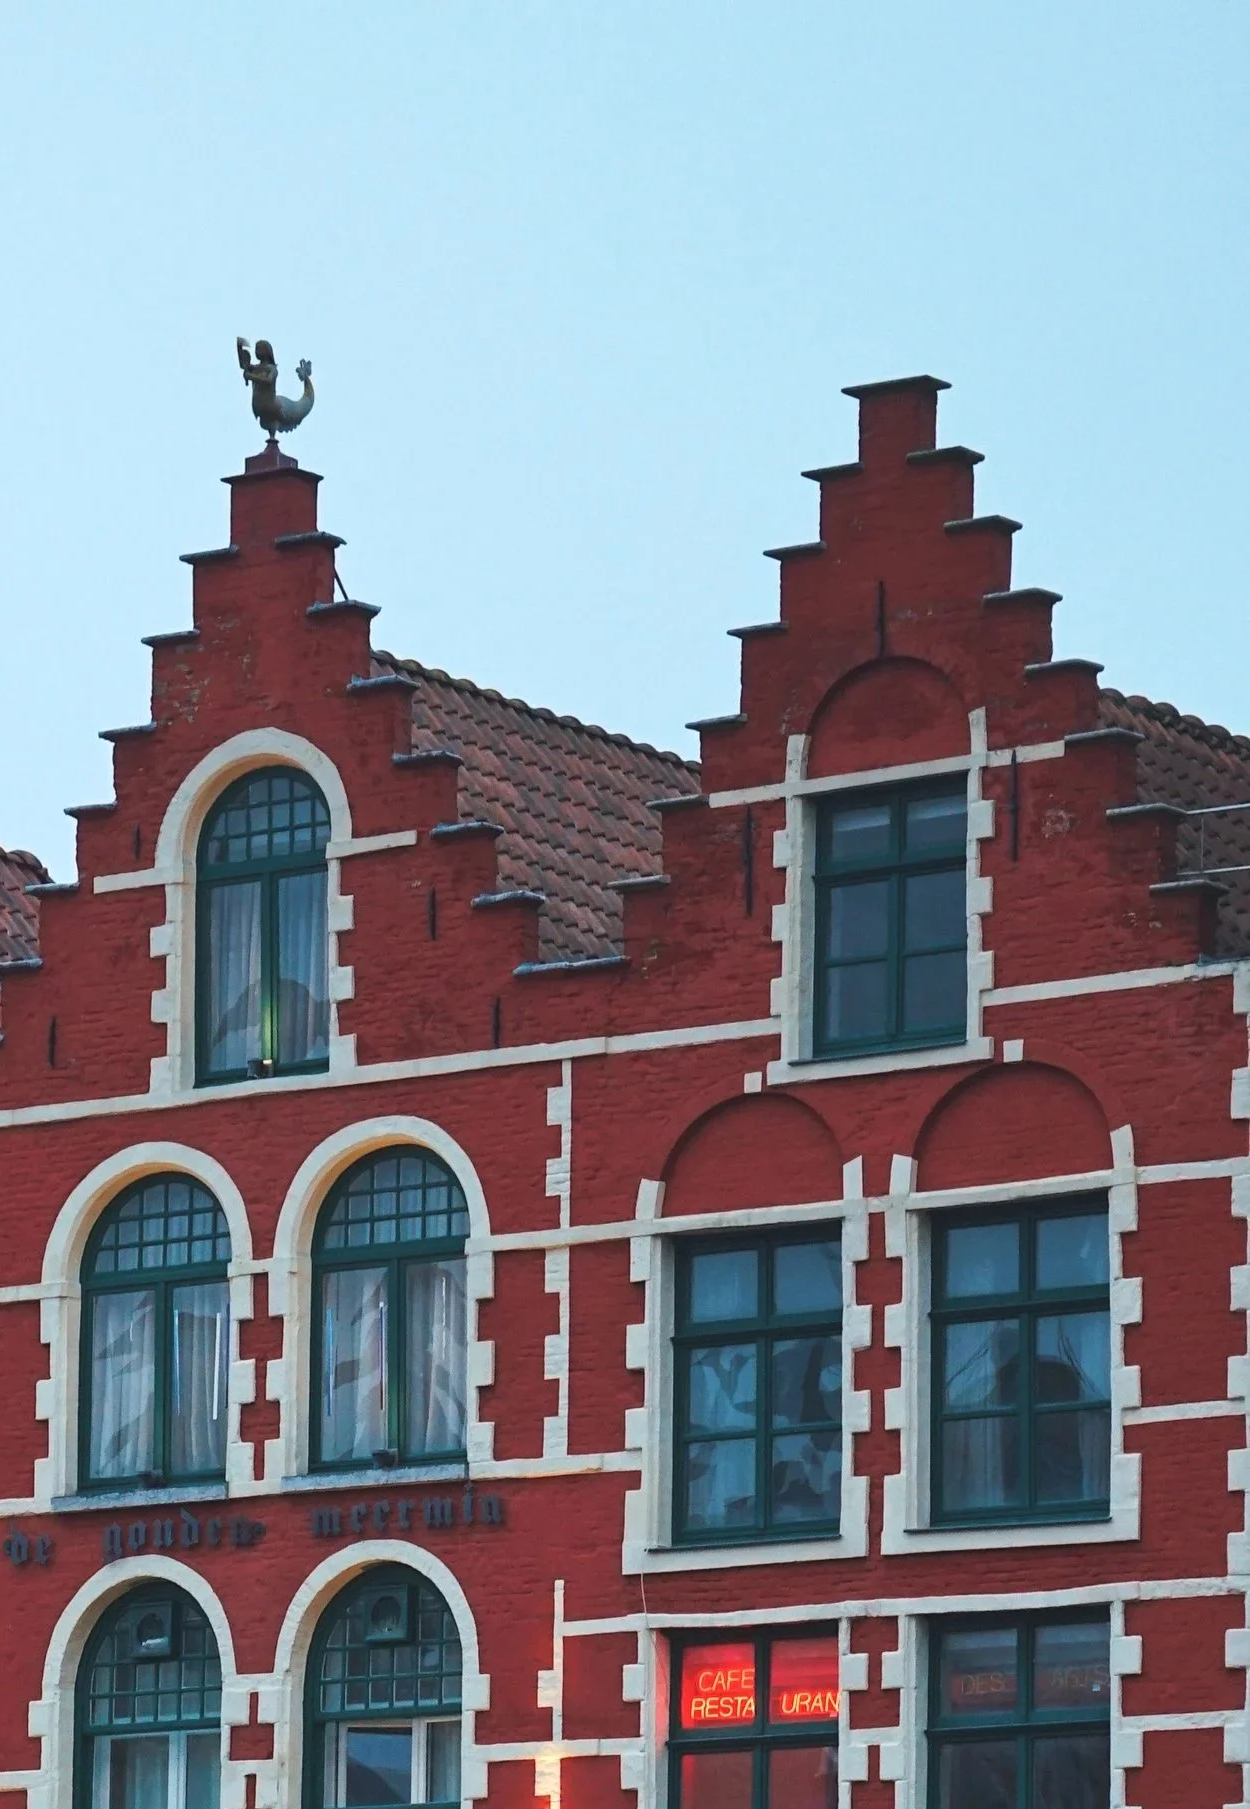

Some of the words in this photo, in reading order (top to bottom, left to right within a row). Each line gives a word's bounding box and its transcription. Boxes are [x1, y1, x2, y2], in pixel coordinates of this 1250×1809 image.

[103, 1507, 259, 1563] gouden
[311, 1484, 504, 1538] meermin
[699, 1668, 756, 1693] CAFE
